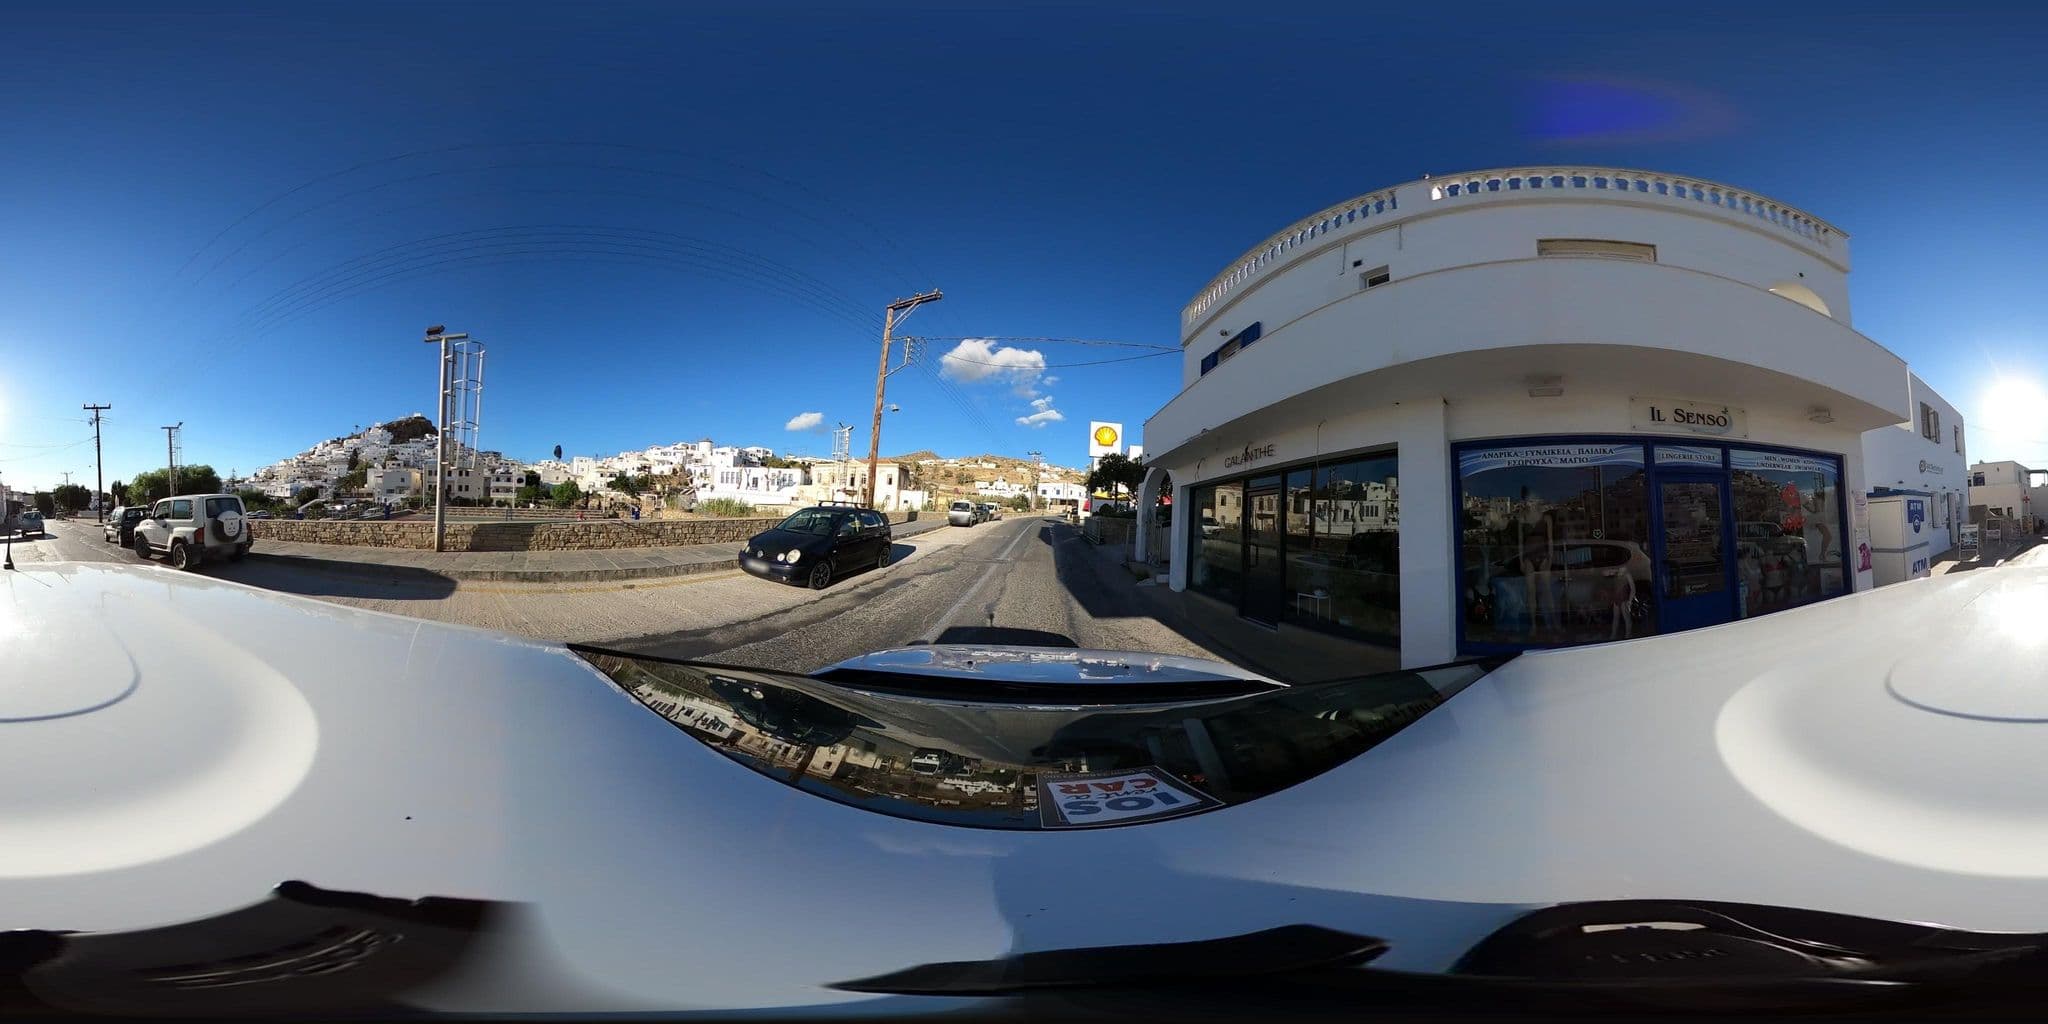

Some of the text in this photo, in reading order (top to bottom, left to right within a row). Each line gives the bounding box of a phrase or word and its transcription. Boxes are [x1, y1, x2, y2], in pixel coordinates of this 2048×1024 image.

[1650, 406, 1728, 427] IL SENSO
[1224, 444, 1274, 468] GALANTHE
[1481, 447, 1615, 459] ΑΝΔΡΙΚΑ ΓΥΝΑΙΚΕΙΑ ΠΑΙΔΙΚΑ
[1559, 456, 1589, 464] ΜΑΓΙΟ
[1909, 501, 1923, 510] ATM
[1912, 557, 1928, 575] ATM
[1058, 778, 1159, 795] CAR
[1096, 787, 1159, 800] rent
[1063, 791, 1181, 816] IOS
